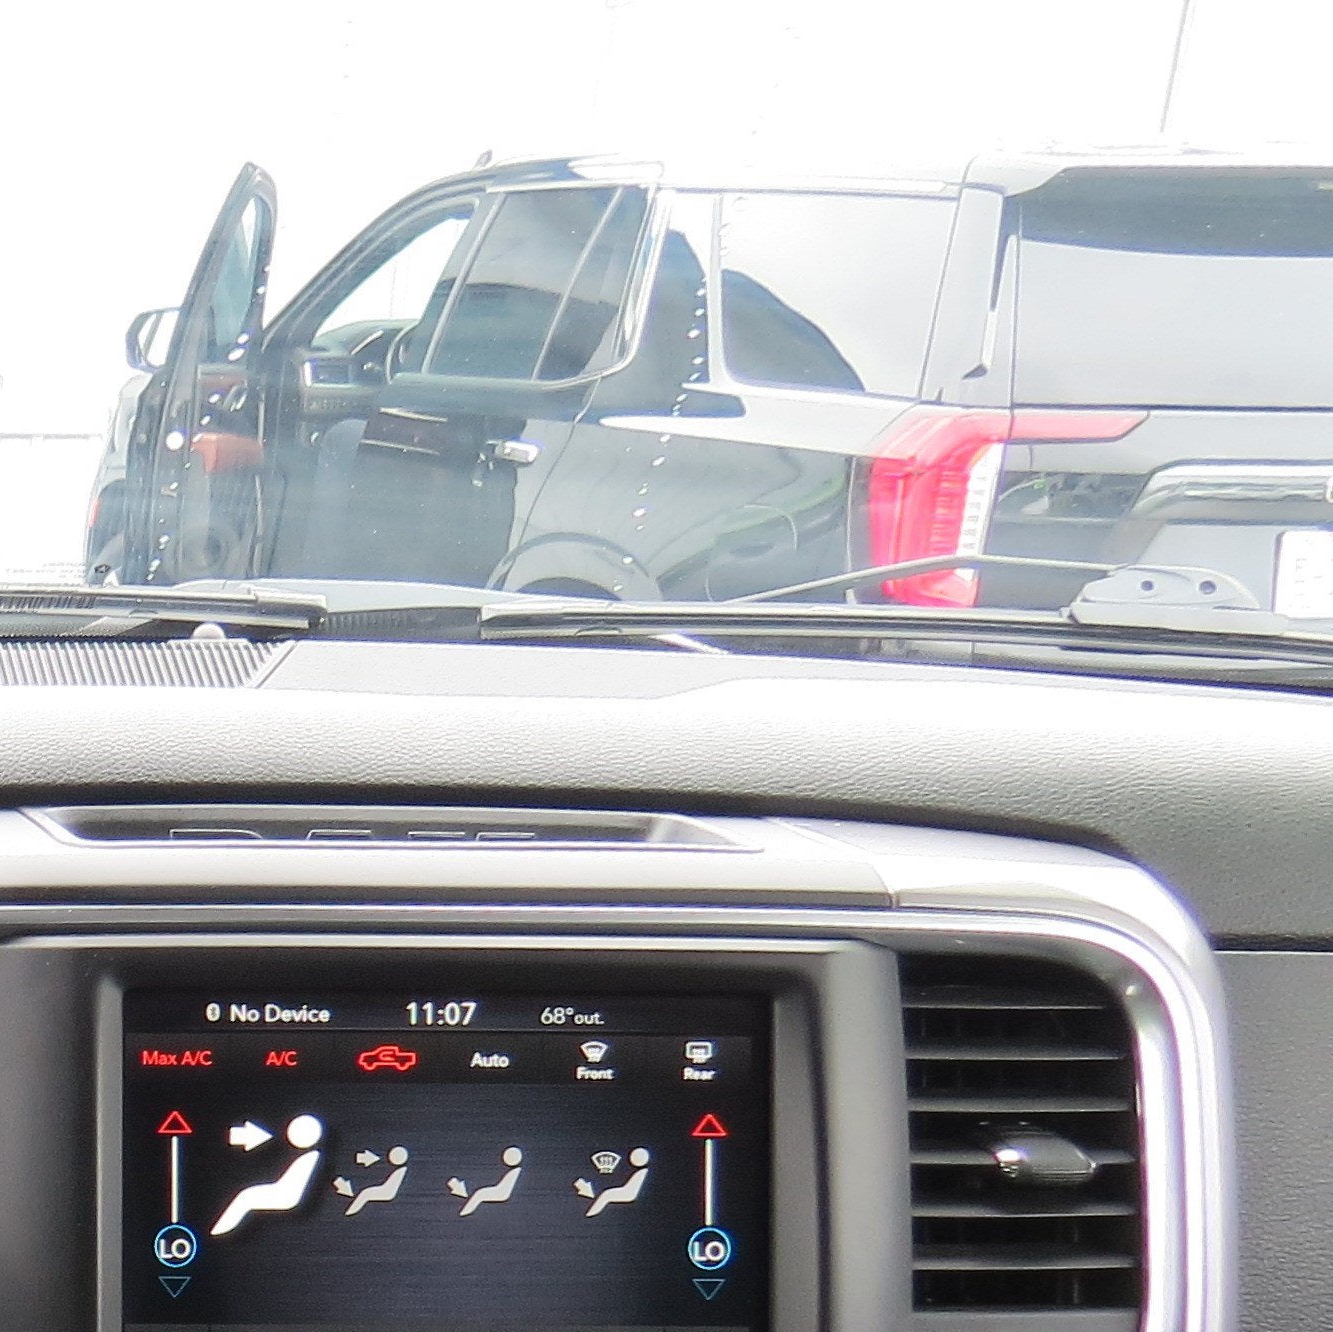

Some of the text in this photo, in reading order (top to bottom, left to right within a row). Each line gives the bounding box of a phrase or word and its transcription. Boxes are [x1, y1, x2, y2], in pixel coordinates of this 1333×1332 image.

[231, 1004, 330, 1023] No Device
[406, 1003, 476, 1026] 11:07
[143, 1051, 212, 1067] Max A/C
[267, 1051, 297, 1067] A/C
[470, 1053, 508, 1068] Auto
[576, 1067, 613, 1080] Front
[684, 1067, 715, 1080] Rear
[160, 1240, 190, 1259] LO
[694, 1241, 724, 1260] LO
